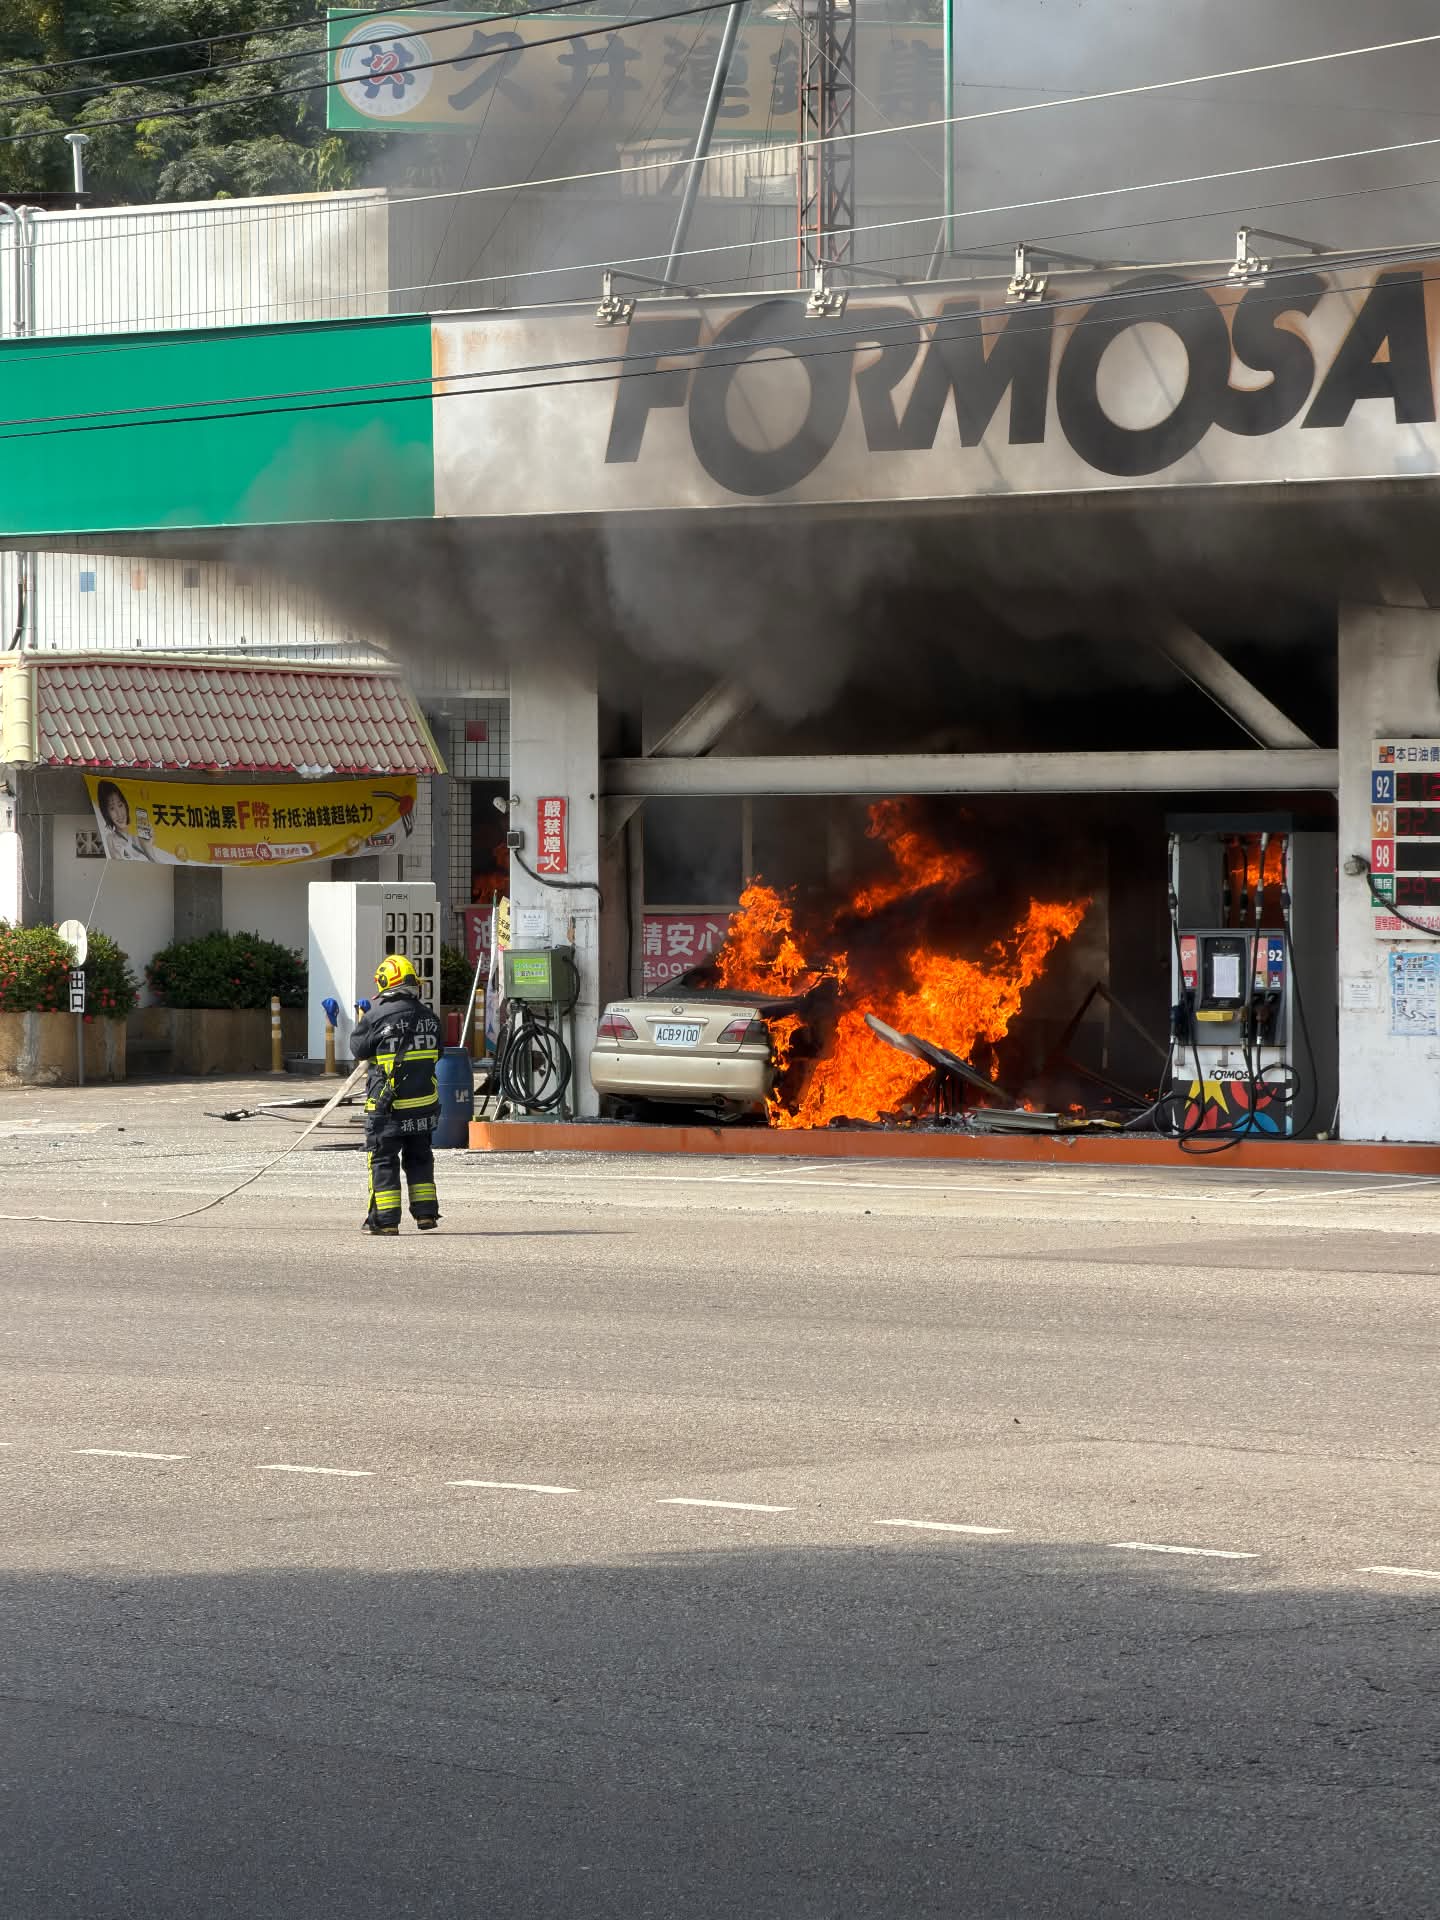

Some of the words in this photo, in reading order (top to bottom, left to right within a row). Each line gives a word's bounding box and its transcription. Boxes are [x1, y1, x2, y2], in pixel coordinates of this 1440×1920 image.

[604, 272, 1437, 497] FORMOSA
[1376, 776, 1390, 798] 92
[1376, 811, 1390, 832] 95
[543, 800, 562, 872] 嚴禁煙火
[1376, 846, 1390, 868] 98
[1268, 949, 1283, 962] 92
[71, 973, 84, 1010] 出口
[1209, 1069, 1250, 1081] FORMOS
